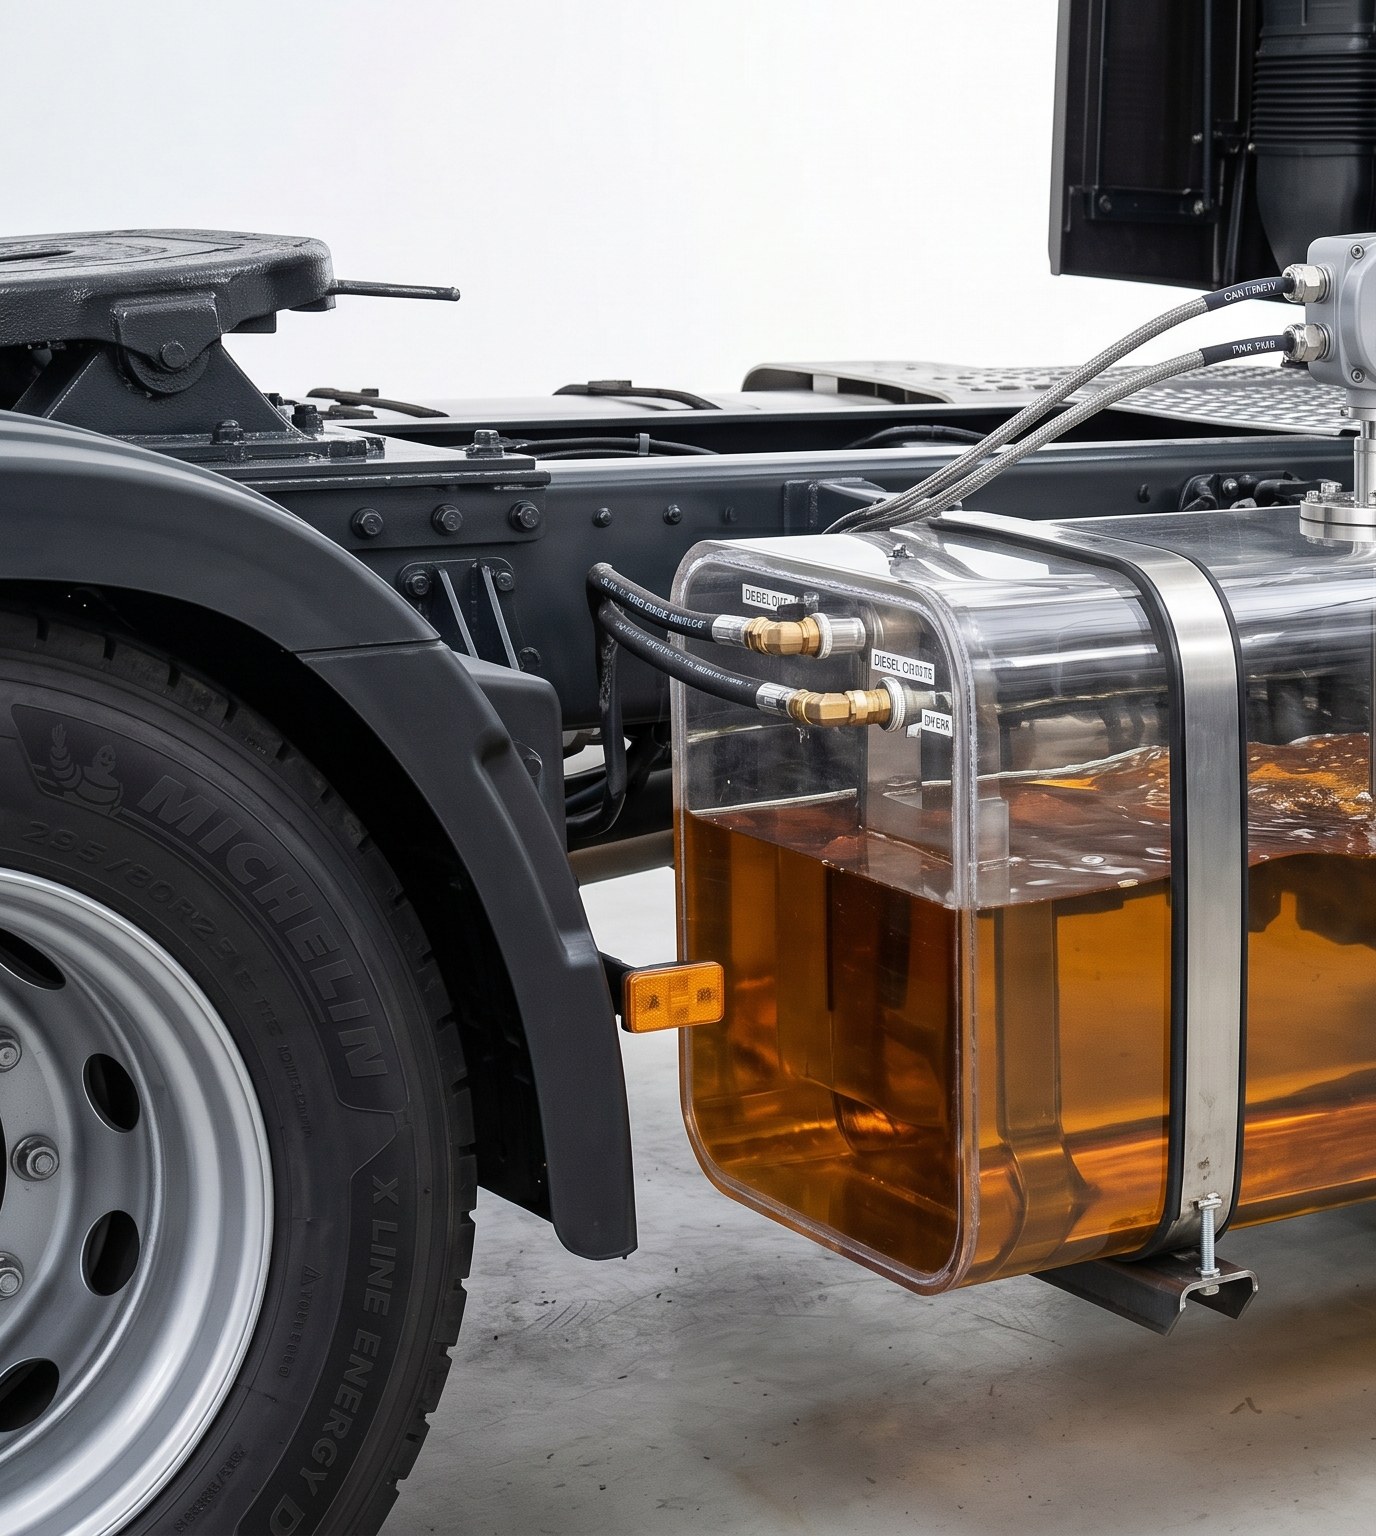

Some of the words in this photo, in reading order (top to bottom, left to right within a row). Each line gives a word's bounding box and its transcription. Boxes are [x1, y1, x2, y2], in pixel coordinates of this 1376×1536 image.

[874, 653, 901, 672] DIESEL
[136, 774, 389, 1079] MICHELIN
[371, 1175, 399, 1207] X
[362, 1218, 399, 1318] LINE
[299, 1327, 382, 1497] ENERGY
[269, 1493, 306, 1536] D
